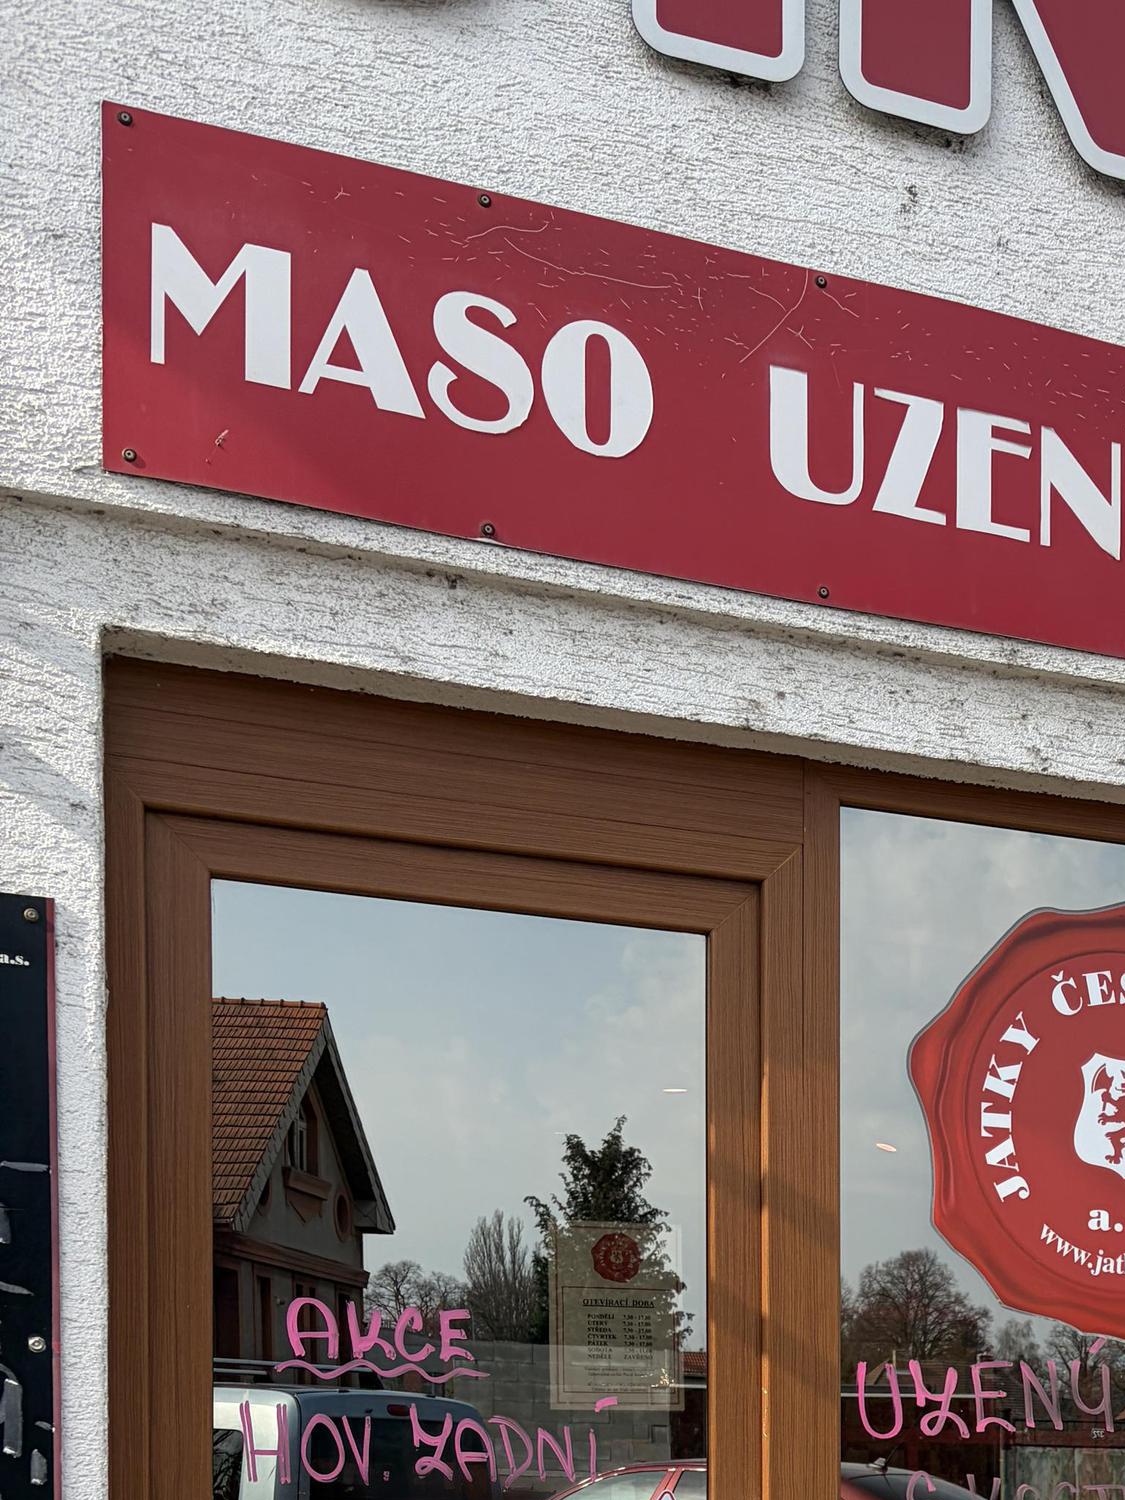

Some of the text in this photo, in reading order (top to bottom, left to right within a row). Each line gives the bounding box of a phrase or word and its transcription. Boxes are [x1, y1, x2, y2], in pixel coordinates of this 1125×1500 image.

[150, 221, 654, 459] MASO
[980, 1011, 1040, 1202] JATKY
[285, 1297, 475, 1363] AKCE
[857, 1337, 1114, 1440] UZENÝ
[239, 1396, 619, 1491] HOV. ZADNÍ
